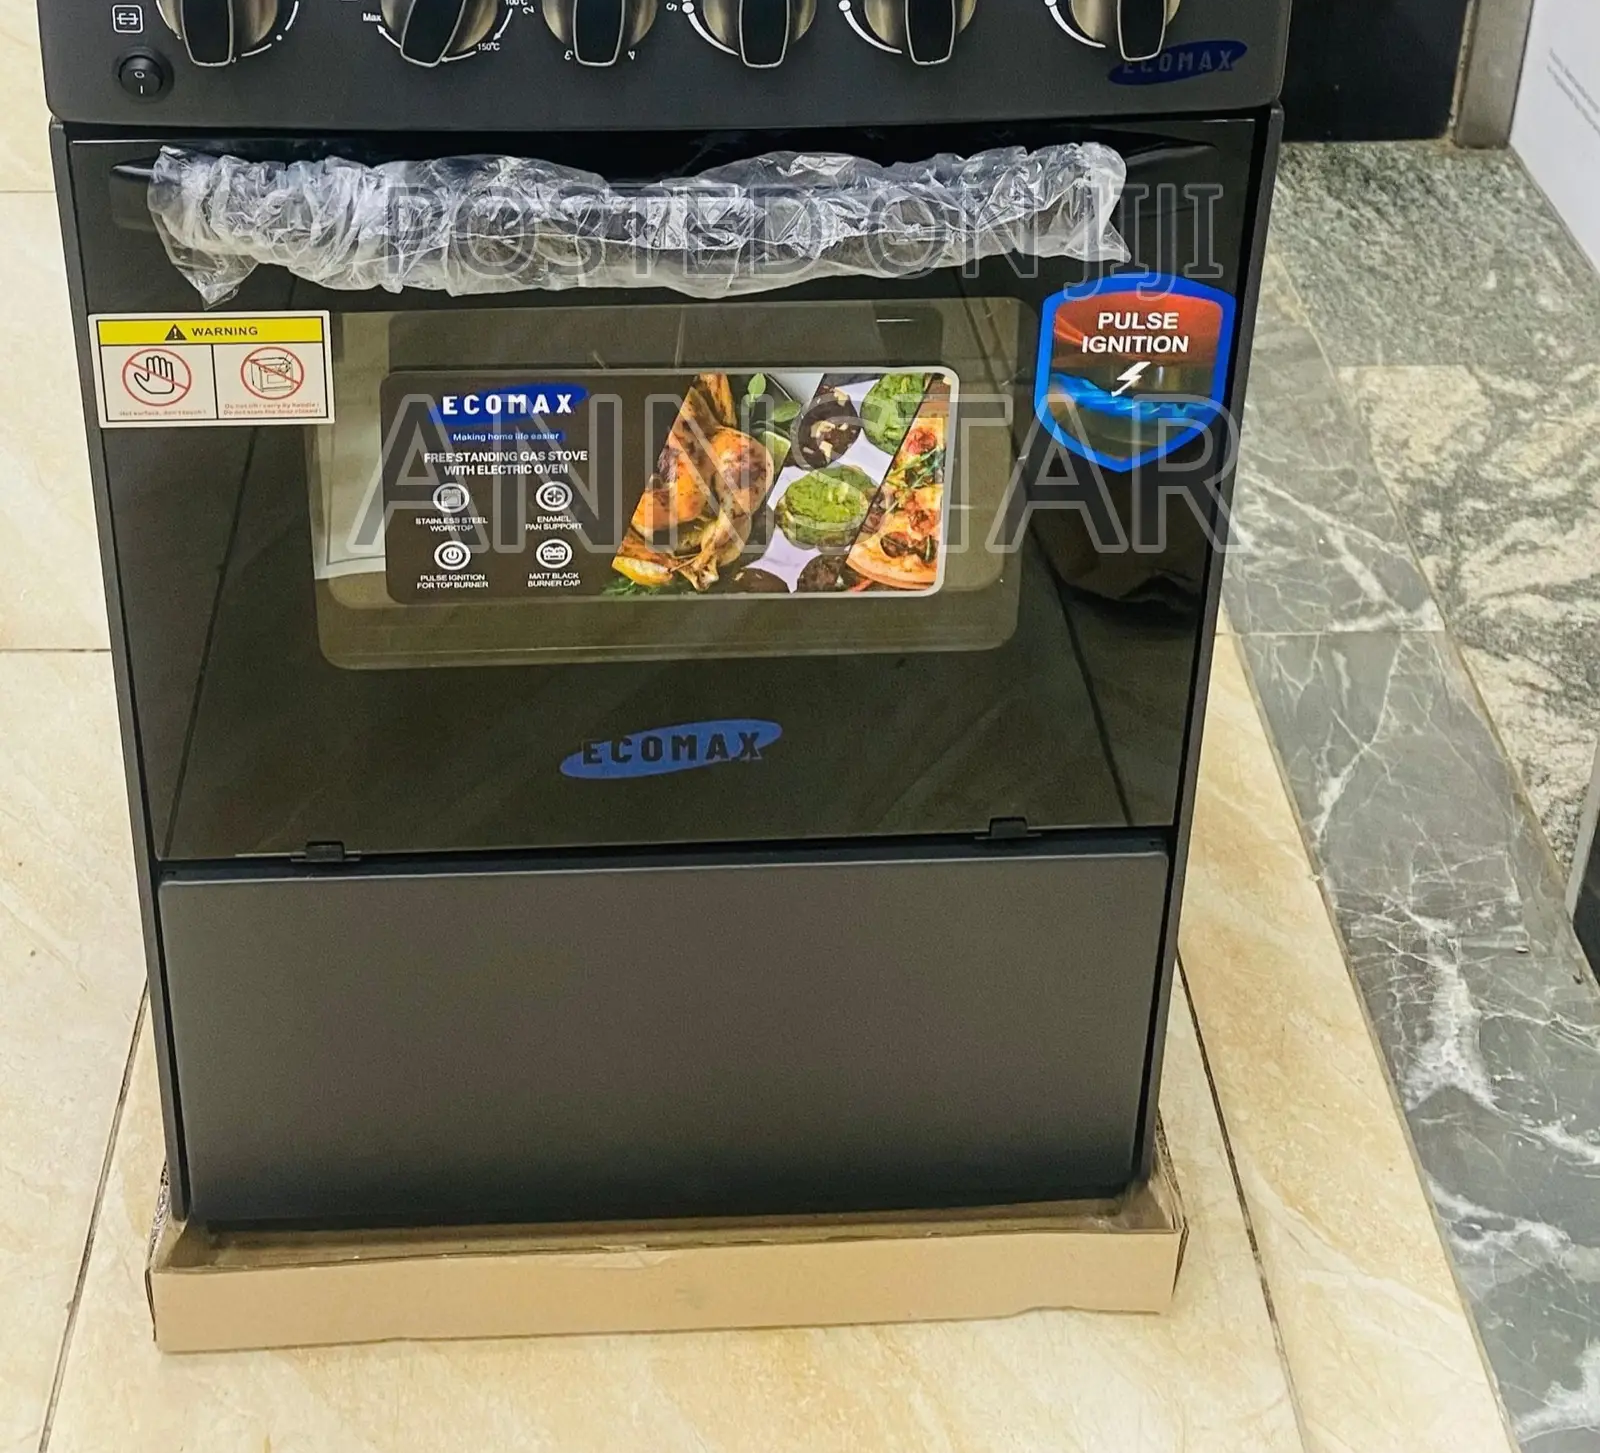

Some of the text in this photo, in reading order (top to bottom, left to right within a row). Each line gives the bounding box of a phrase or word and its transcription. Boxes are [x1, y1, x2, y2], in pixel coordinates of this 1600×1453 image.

[363, 13, 382, 22] Max
[1097, 312, 1180, 330] PULSE
[191, 326, 258, 337] WARNING
[1081, 335, 1190, 353] IGNITION
[442, 394, 572, 416] ECOMAX
[452, 432, 560, 443] Making home life easier
[519, 451, 546, 462] GAS
[547, 450, 588, 461] STOVE
[444, 463, 568, 476] WITH ELECTRIC OVEN
[415, 516, 489, 525] STAINLESS STEEL
[536, 515, 572, 523] ENAMEL
[429, 524, 474, 532] WORKTOP
[525, 522, 583, 531] PAN SUPPORT
[420, 573, 485, 582] PULSE IGNITION
[528, 572, 579, 580] MATT BLACK
[416, 581, 489, 590] FOR TOP BURNER
[527, 579, 581, 588] BURNER CAP
[581, 732, 763, 766] ECOMAX
